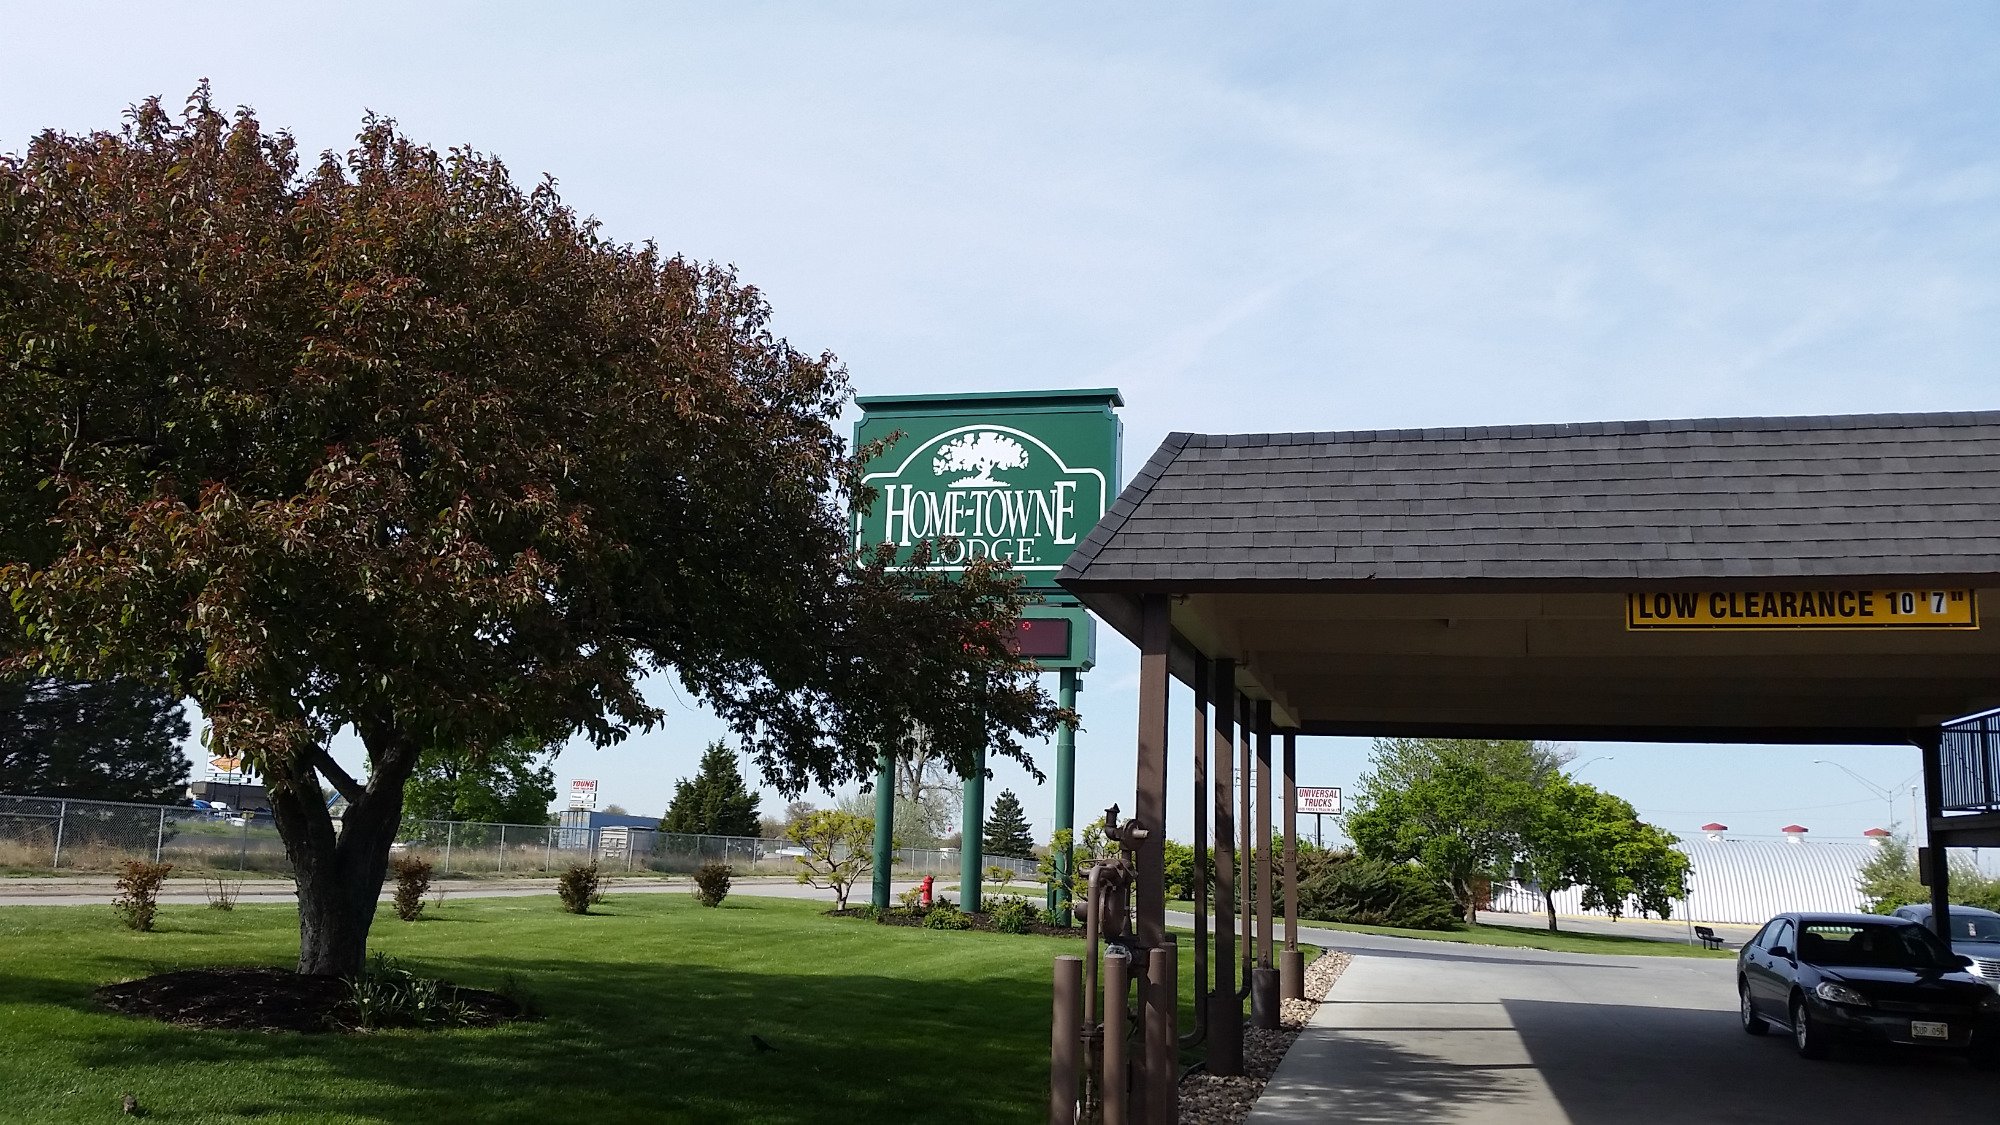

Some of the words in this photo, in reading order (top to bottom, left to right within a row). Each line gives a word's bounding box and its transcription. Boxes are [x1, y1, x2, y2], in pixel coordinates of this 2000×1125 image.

[885, 480, 1077, 547] HOME-TOWNE
[1639, 590, 1699, 619] LOW
[1709, 590, 1874, 618] CLEARANCE
[1299, 789, 1338, 798] UNIVERSAL
[1305, 798, 1333, 807] TRUCKS
